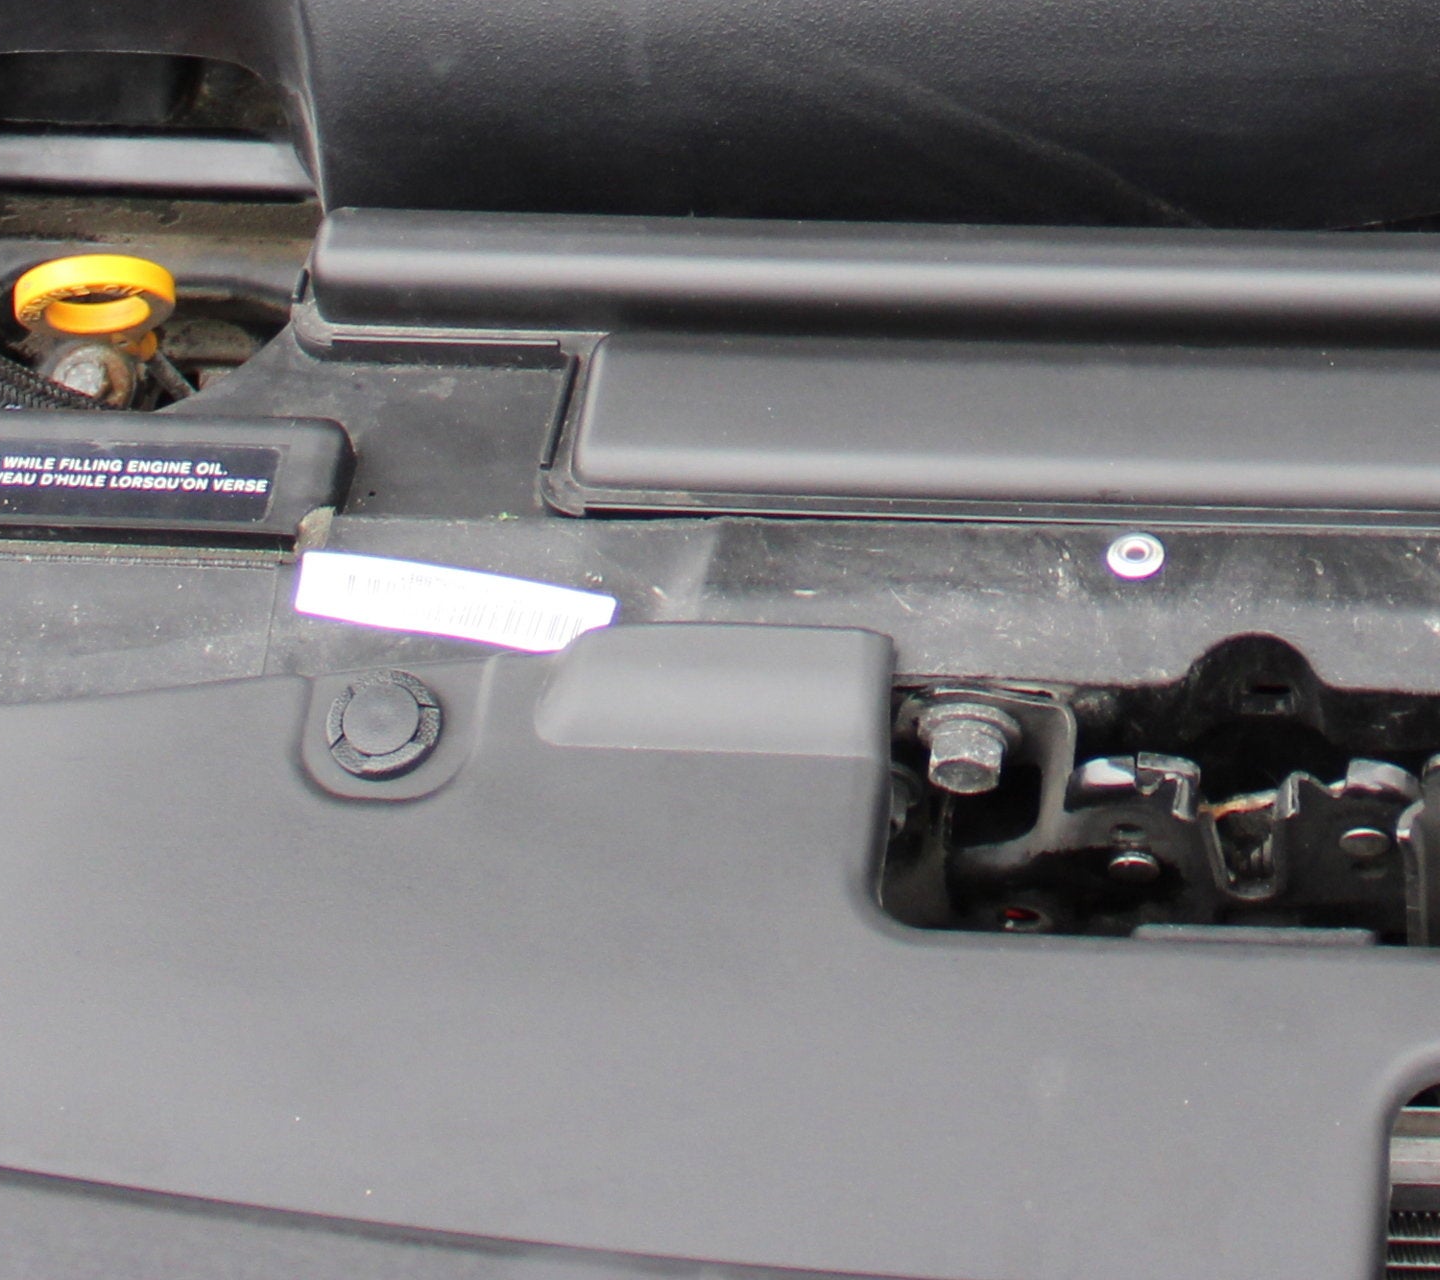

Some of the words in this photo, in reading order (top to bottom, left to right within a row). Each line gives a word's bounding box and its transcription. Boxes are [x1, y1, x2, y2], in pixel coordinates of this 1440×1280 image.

[3, 456, 56, 470] WHILE
[59, 458, 122, 472] FILLING
[126, 460, 191, 474] ENGINE
[196, 462, 228, 476] OIL.
[40, 474, 107, 488] D'HUILE
[110, 475, 208, 491] LORSQU'ON
[212, 478, 268, 493] VERSE
